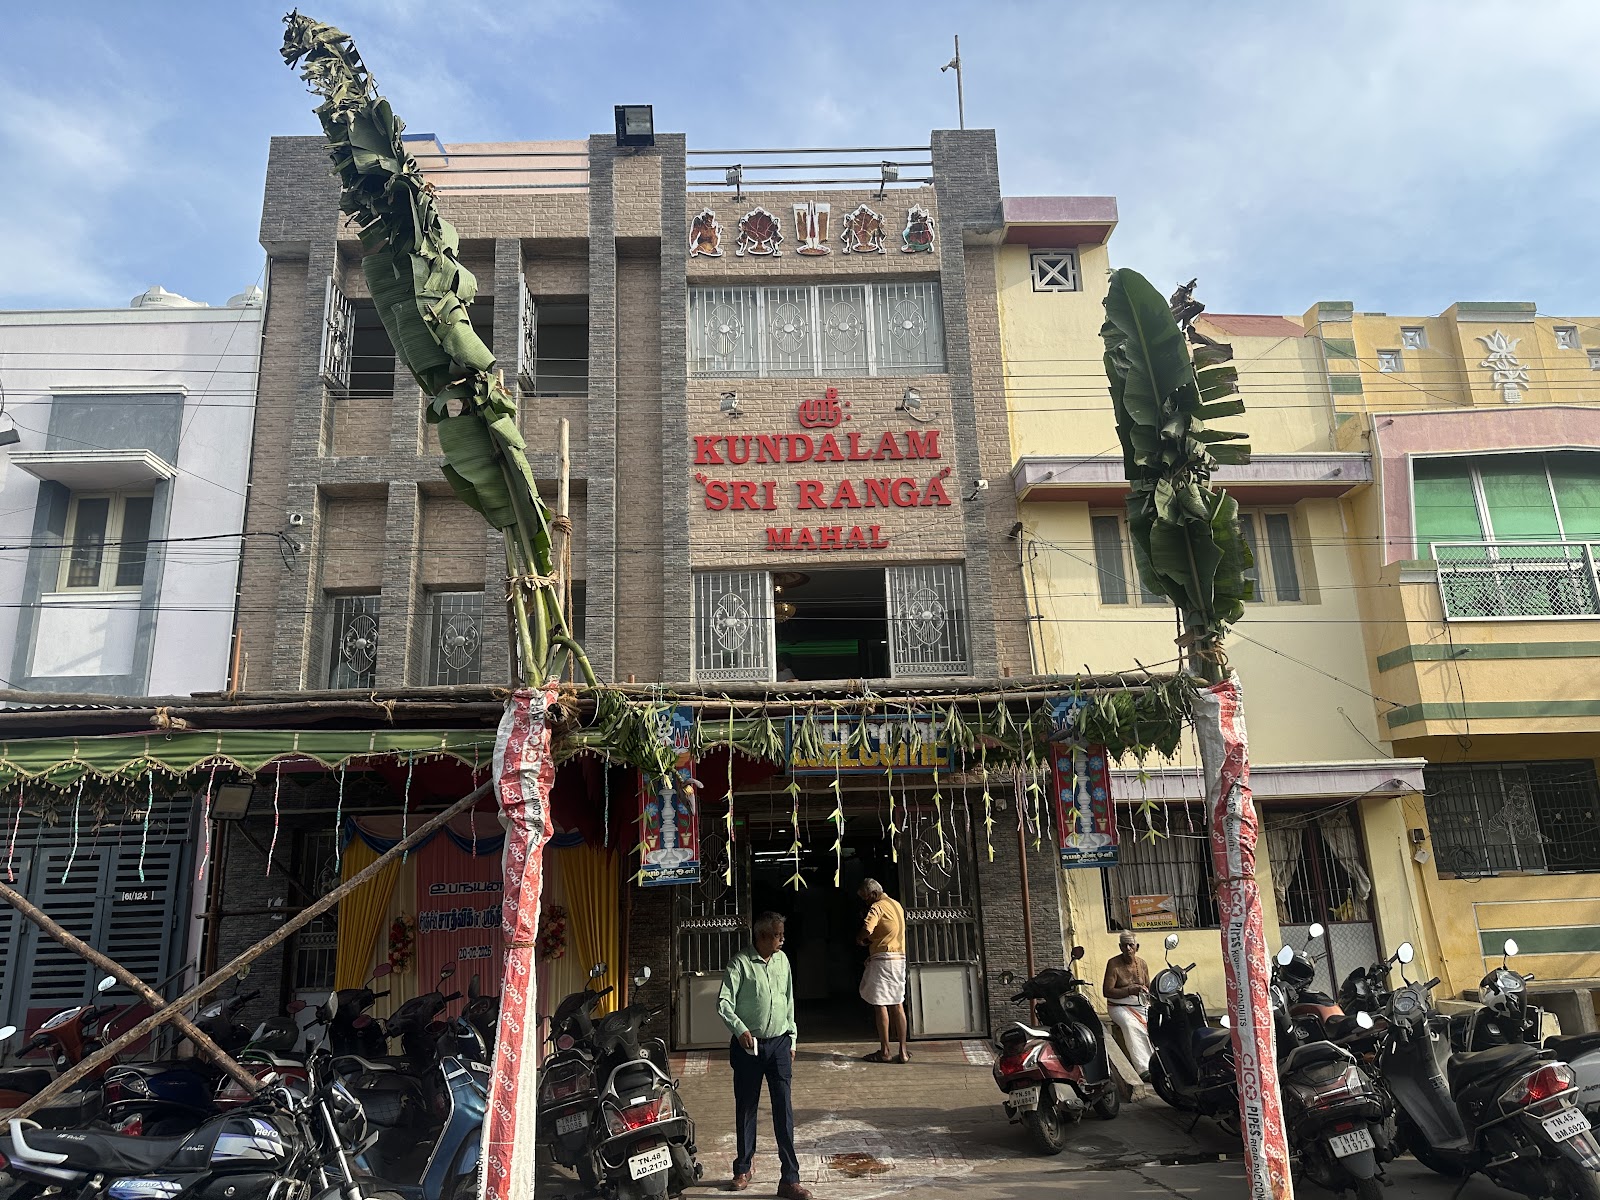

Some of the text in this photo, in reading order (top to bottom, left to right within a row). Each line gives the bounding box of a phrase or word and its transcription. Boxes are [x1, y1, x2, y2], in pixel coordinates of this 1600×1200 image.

[693, 430, 942, 465] KUNDALAM
[765, 525, 890, 551] MAHAL
[524, 722, 544, 763] CICO
[501, 786, 522, 803] CICO
[510, 843, 525, 862] CICO
[507, 867, 521, 886] CICO
[429, 882, 503, 895] உபநயன
[510, 955, 526, 976] CICO
[505, 983, 523, 1005] CICO
[502, 1011, 520, 1033] CICO
[1253, 1005, 1269, 1025] CICO
[499, 1041, 517, 1062] CICO
[497, 1070, 514, 1091] CICO
[1243, 1053, 1257, 1100] CICO
[493, 1100, 511, 1121] CICO
[1246, 1105, 1262, 1137] PIPES
[254, 1127, 279, 1138] Hero
[1554, 1121, 1587, 1140] BM.6927
[1250, 1138, 1258, 1161] RIGID
[1265, 1143, 1286, 1163] CICO
[1342, 1139, 1370, 1154] A1973
[488, 1155, 507, 1178] CICO
[635, 1159, 668, 1177] AD.2170
[637, 1152, 662, 1166] TN.48
[1253, 1162, 1262, 1180] PVC
